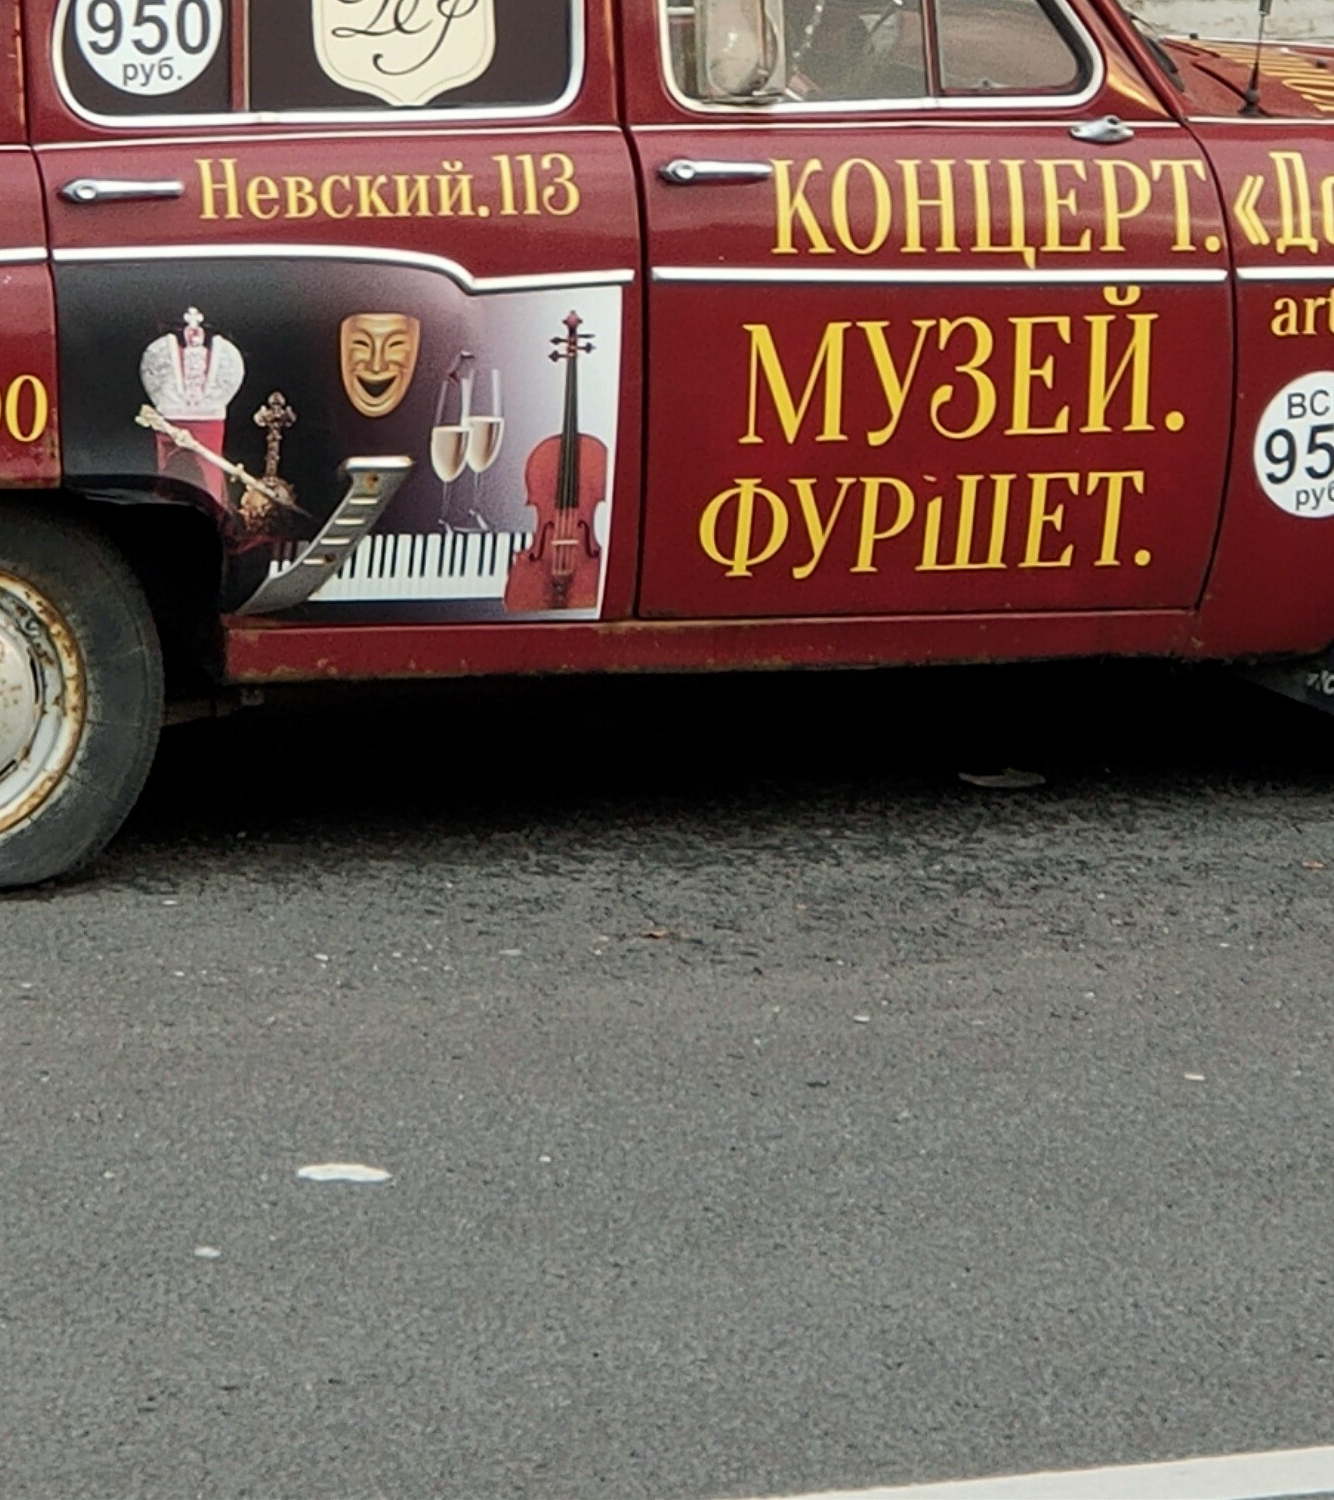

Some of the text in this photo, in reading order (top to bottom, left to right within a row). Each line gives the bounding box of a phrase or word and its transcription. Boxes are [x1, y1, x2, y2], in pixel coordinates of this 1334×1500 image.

[121, 58, 184, 87] руб.
[769, 156, 1224, 271] КОНЦЕРТ.
[739, 285, 1186, 446] МУЗЕЙ.
